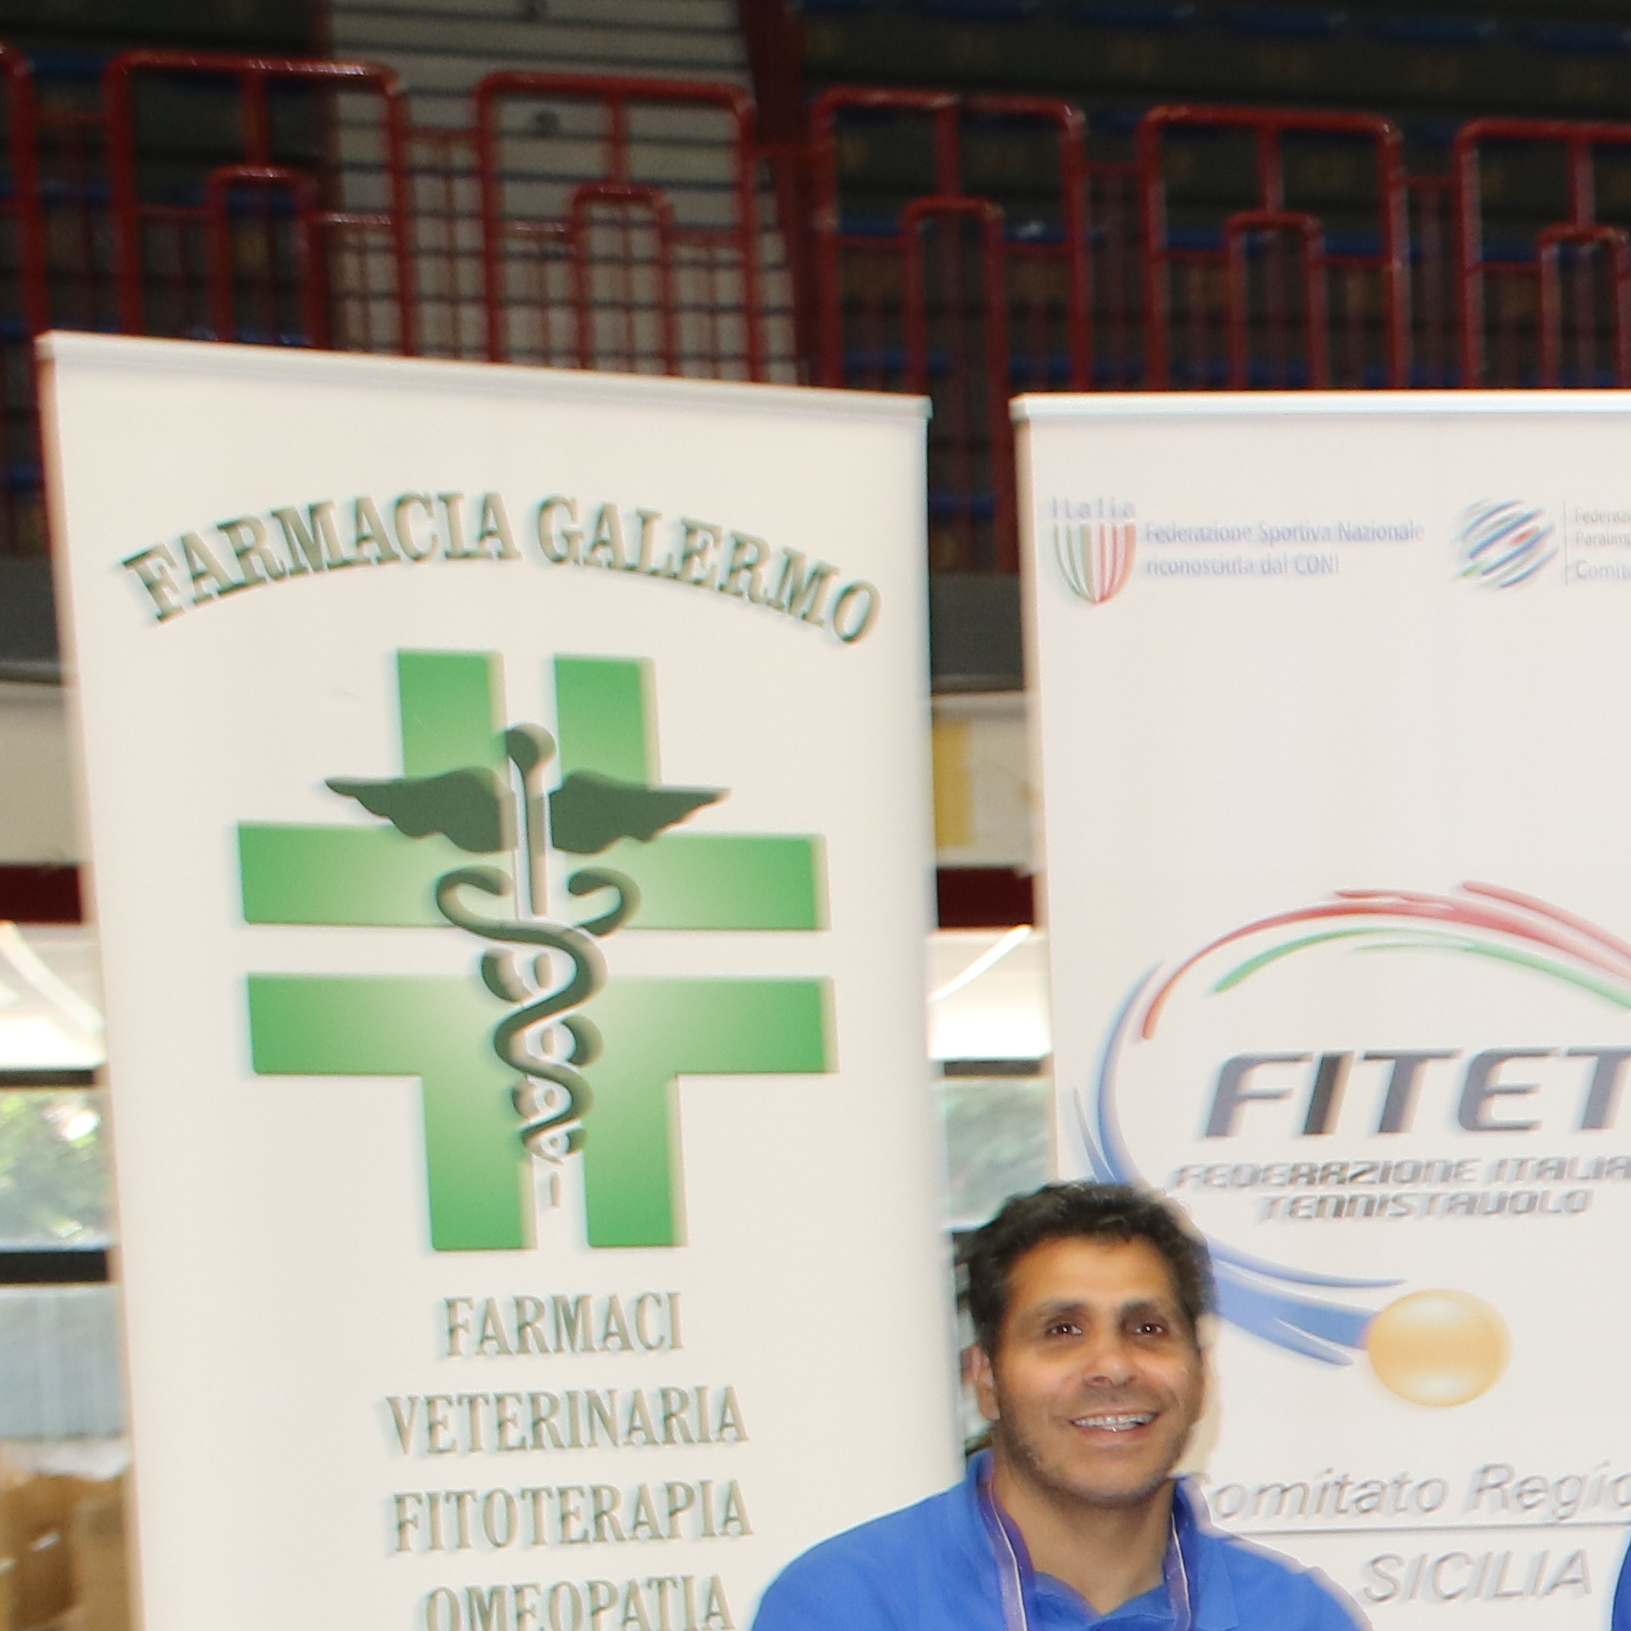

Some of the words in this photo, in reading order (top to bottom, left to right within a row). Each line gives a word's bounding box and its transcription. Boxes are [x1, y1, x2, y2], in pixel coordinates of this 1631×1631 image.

[1050, 497, 1137, 519] Italia
[1144, 521, 1252, 543] Federazione
[1258, 519, 1333, 547] Sportiva
[1338, 518, 1424, 542] Nazionale
[121, 491, 522, 624] FARMACIA
[535, 494, 883, 646] GALERMO
[1145, 553, 1254, 576] riconosciuta
[1260, 553, 1289, 576] dal
[1296, 552, 1339, 575] CONI
[1170, 1157, 1483, 1191] FEDERAZIONE
[443, 1291, 685, 1360] FARMACI
[385, 1385, 750, 1456] VETERINARIA
[392, 1479, 754, 1554] FITOTERAPIA
[1361, 1549, 1594, 1605] SICILIA
